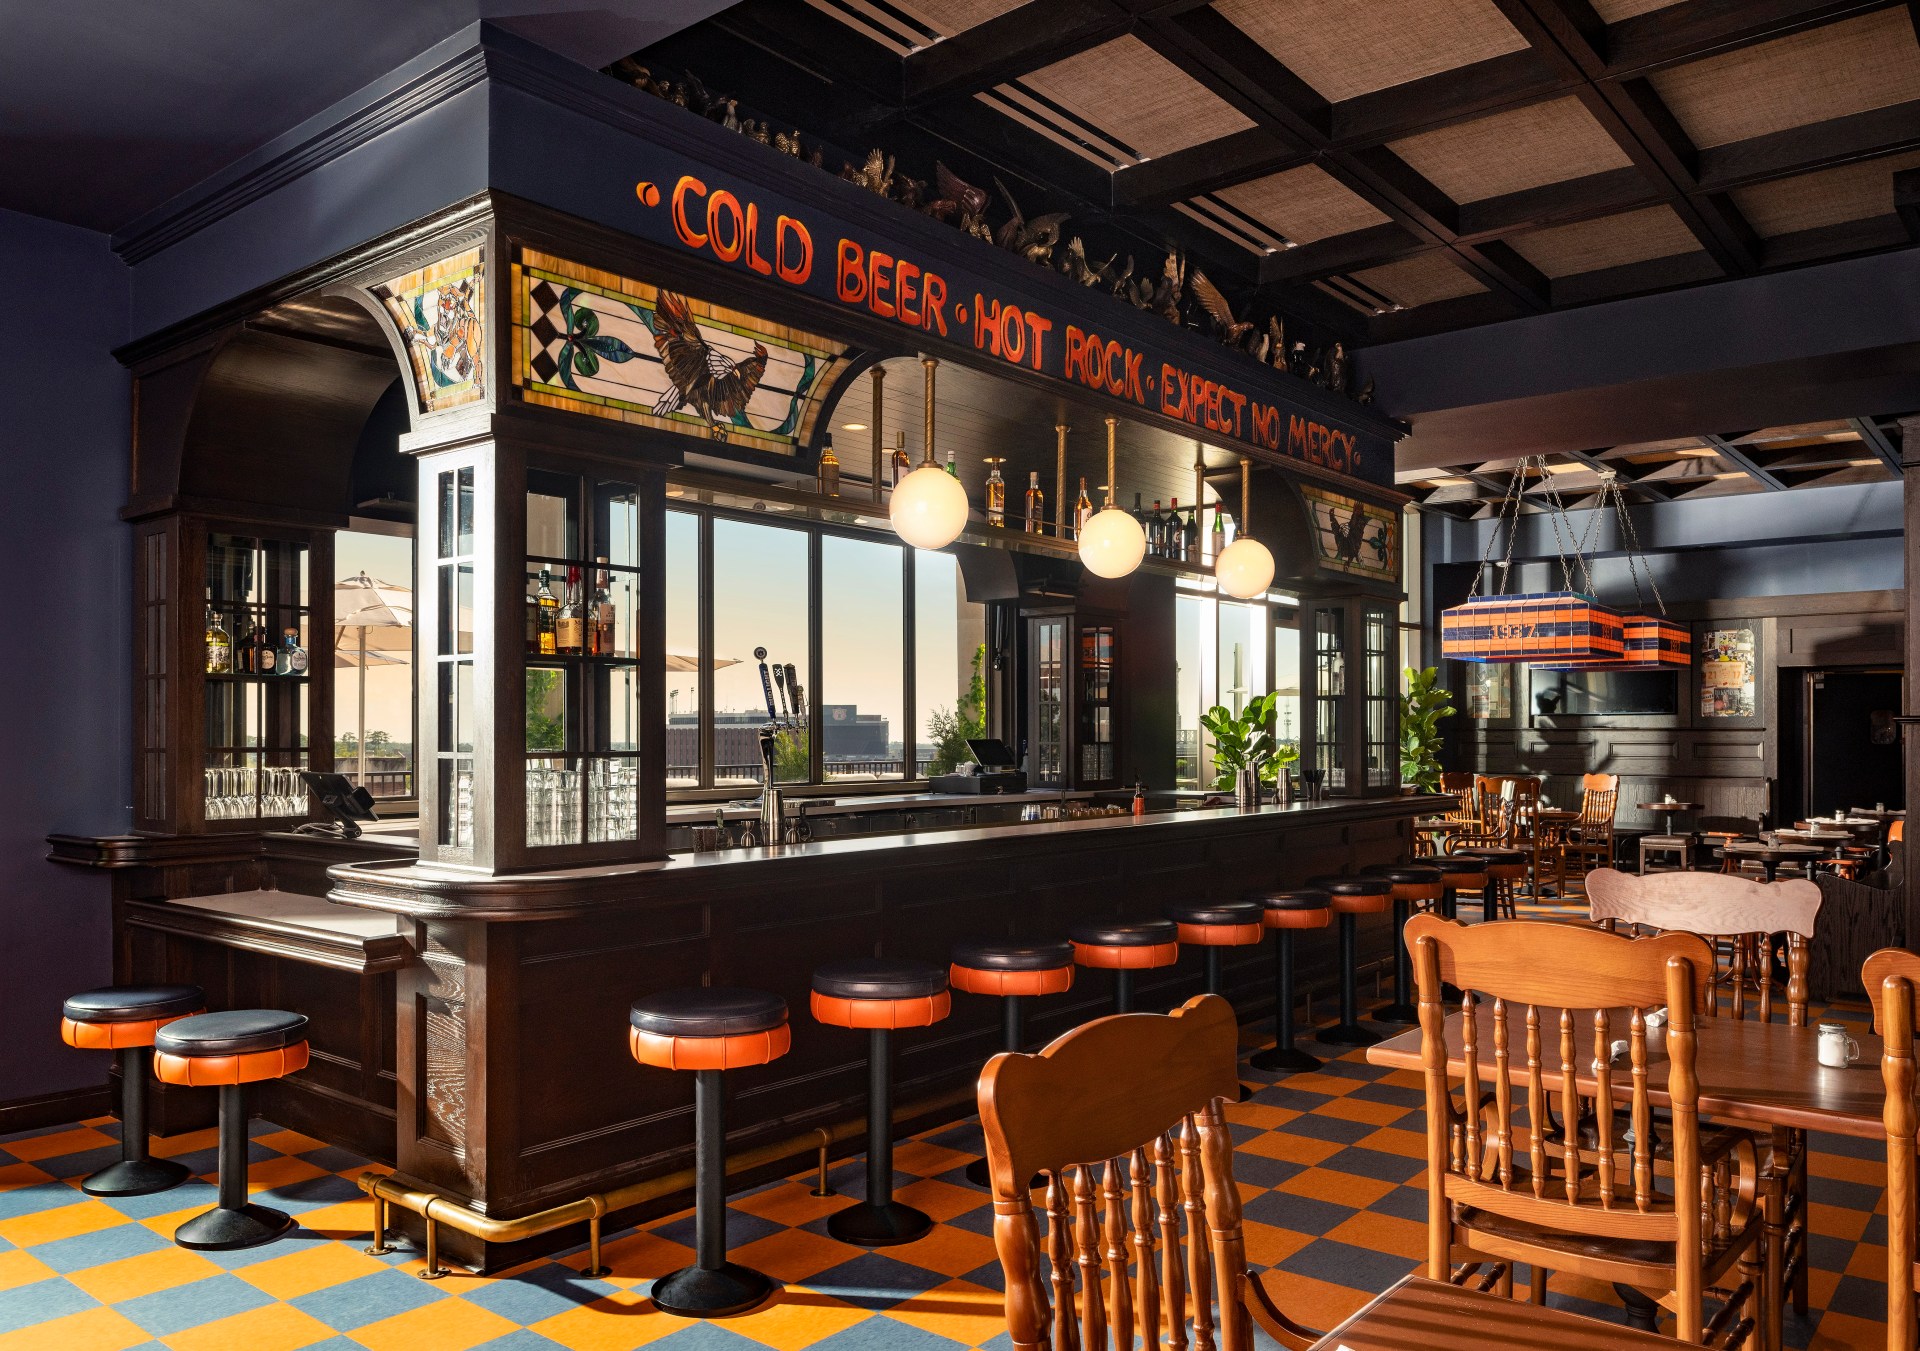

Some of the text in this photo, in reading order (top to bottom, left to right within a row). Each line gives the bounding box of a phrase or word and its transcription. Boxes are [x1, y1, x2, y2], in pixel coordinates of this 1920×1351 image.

[672, 175, 1356, 475] COLD BEER HOT ROCK EXPECT NO MERCY
[1490, 623, 1537, 640] 1937
